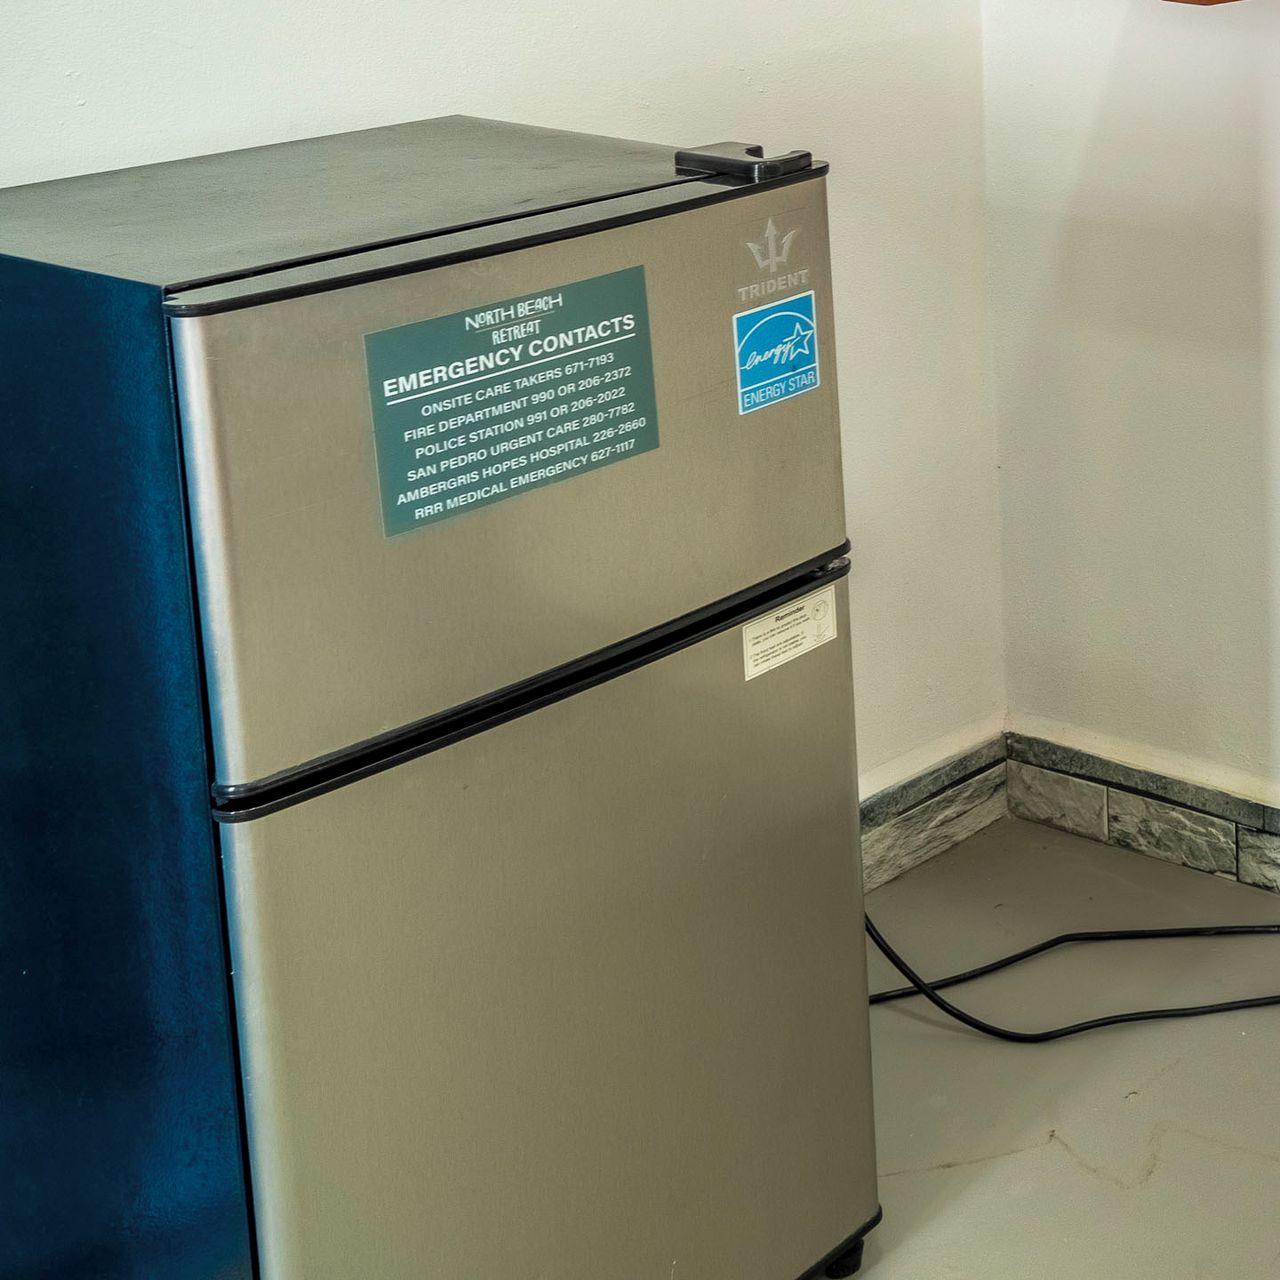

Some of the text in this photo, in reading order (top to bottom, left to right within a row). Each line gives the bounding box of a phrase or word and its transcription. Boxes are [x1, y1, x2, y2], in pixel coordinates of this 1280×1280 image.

[464, 293, 563, 331] NORTH BEACH
[738, 269, 809, 302] TRIDENT
[382, 314, 636, 398] EMERGENCY CONTACTS
[491, 320, 542, 346] RETREAT
[403, 366, 632, 443] FIRE DEPARTMENT 990 OR 206-2372
[420, 352, 615, 417] ONSITE CARE TAKERS 671-7193
[743, 371, 815, 407] ENERGY STAR
[407, 402, 636, 482] SAN PEDRO URGENT CARE 280-7782
[415, 386, 626, 460] POLICE STATION 991 OR 206-2022
[396, 417, 647, 506] AMBERGRIS HOPES HOSPITAL 226-2660
[414, 439, 636, 520] RRR MEDICAL EMERGENCY 627-1117
